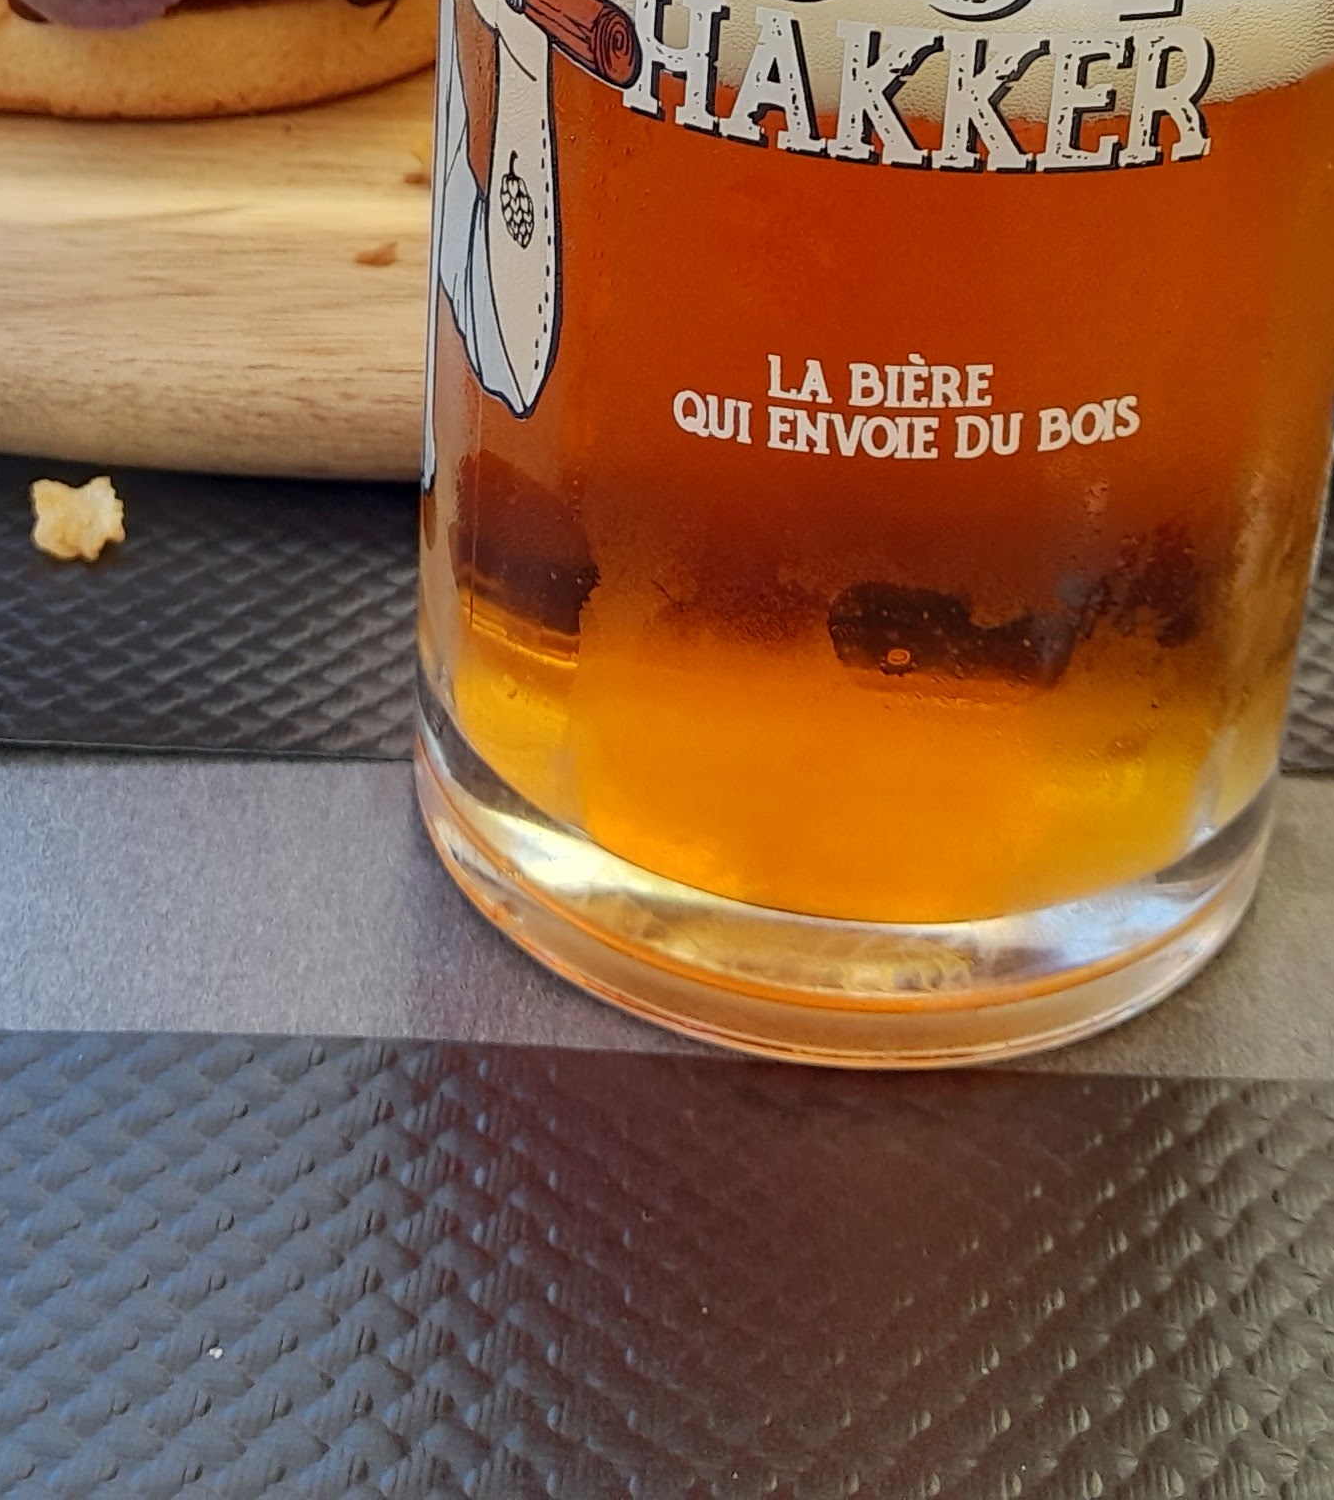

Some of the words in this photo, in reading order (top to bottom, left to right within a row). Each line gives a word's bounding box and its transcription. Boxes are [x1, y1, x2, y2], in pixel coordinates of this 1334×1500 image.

[767, 353, 833, 404] LA
[848, 352, 994, 409] BIÈRE
[672, 389, 753, 445] QUI
[767, 405, 940, 460] ENVOIE
[954, 411, 1024, 460] DU
[1037, 395, 1142, 453] BOIS
